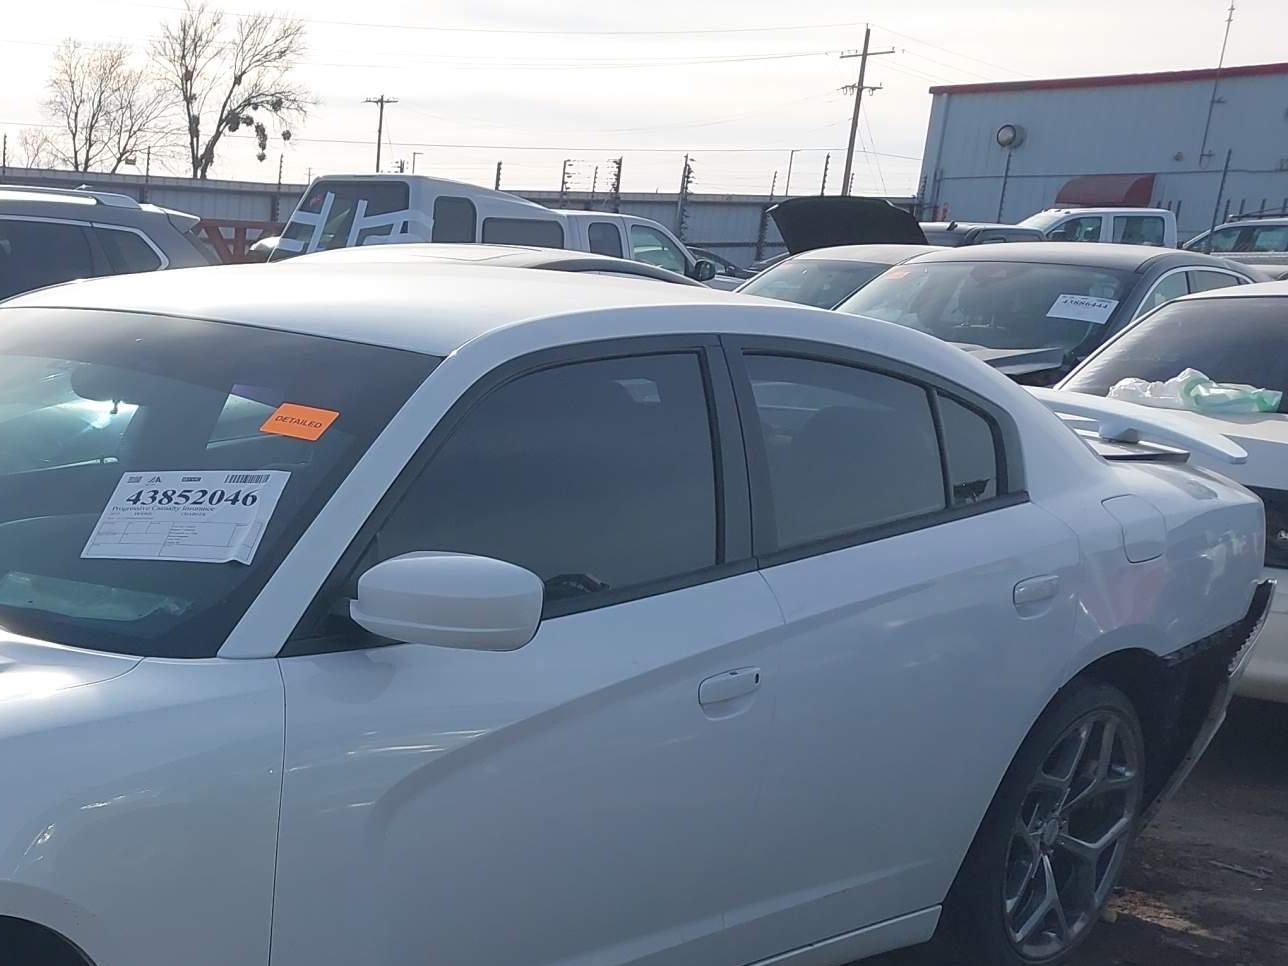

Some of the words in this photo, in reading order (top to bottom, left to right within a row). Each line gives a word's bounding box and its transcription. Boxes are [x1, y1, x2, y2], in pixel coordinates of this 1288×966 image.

[275, 415, 322, 428] DETAILED
[126, 489, 262, 506] 43852046
[112, 505, 152, 513] Progressive
